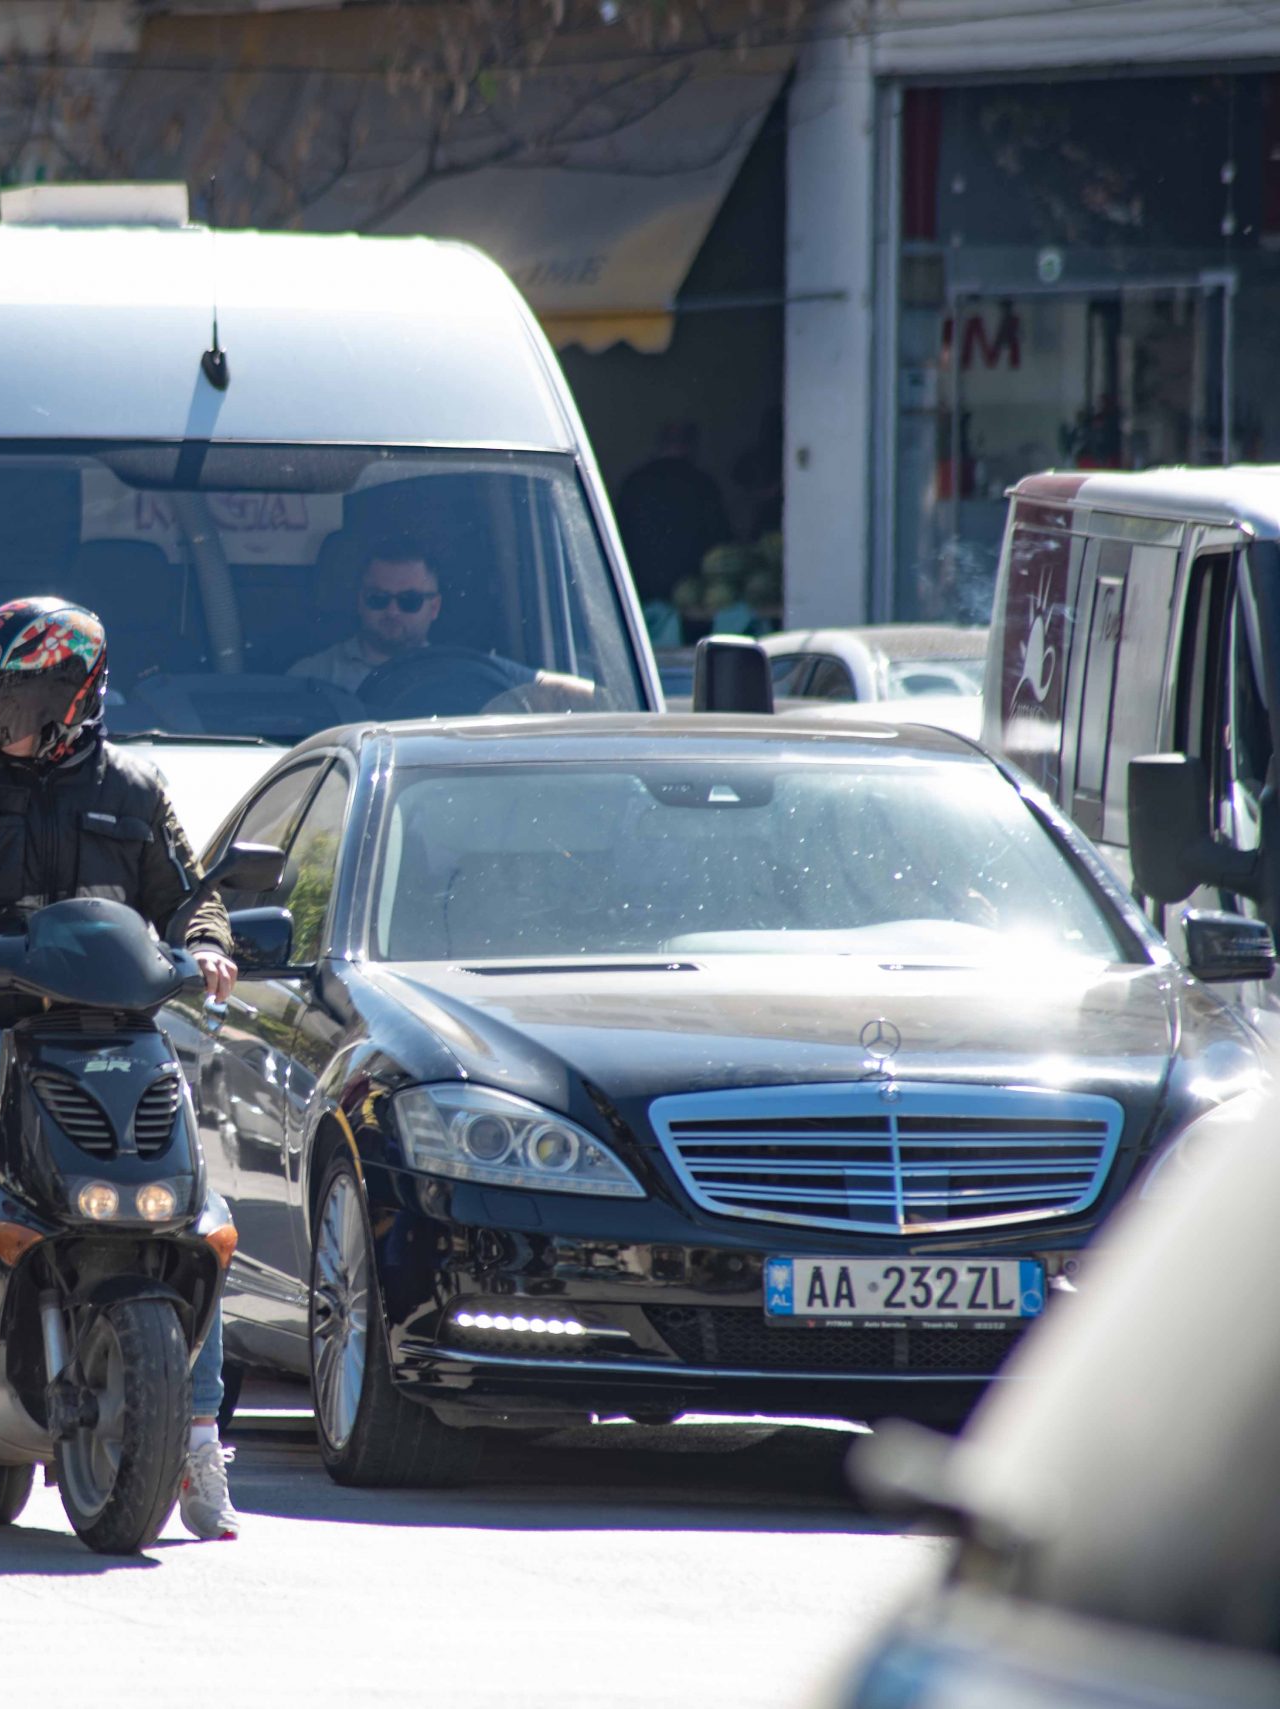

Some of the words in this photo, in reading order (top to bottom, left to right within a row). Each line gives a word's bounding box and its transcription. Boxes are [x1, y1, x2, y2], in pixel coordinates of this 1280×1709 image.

[84, 1060, 132, 1072] SR
[771, 1293, 790, 1306] AL
[806, 1266, 856, 1308] AA
